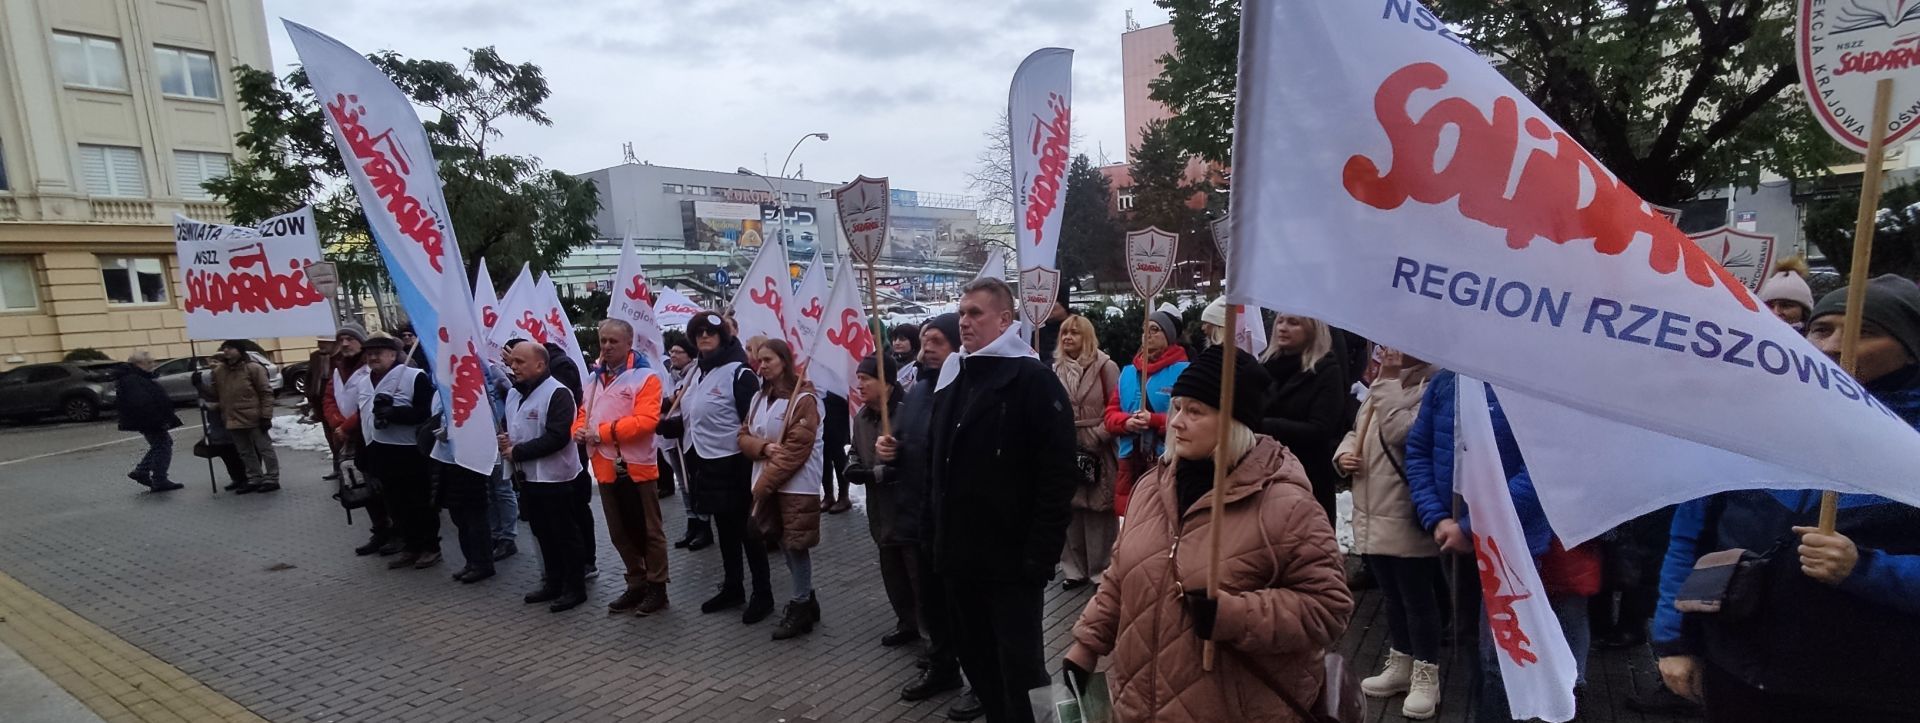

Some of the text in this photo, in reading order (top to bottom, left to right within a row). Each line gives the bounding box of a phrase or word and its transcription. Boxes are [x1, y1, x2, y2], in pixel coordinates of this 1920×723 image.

[1836, 40, 1864, 50] NSZZ
[1814, 64, 1866, 136] KRAJOWA
[194, 250, 220, 264] NSZZ
[1748, 240, 1768, 290] WYCHOWANIA
[1392, 257, 1571, 328] REGION
[621, 302, 655, 325] Region
